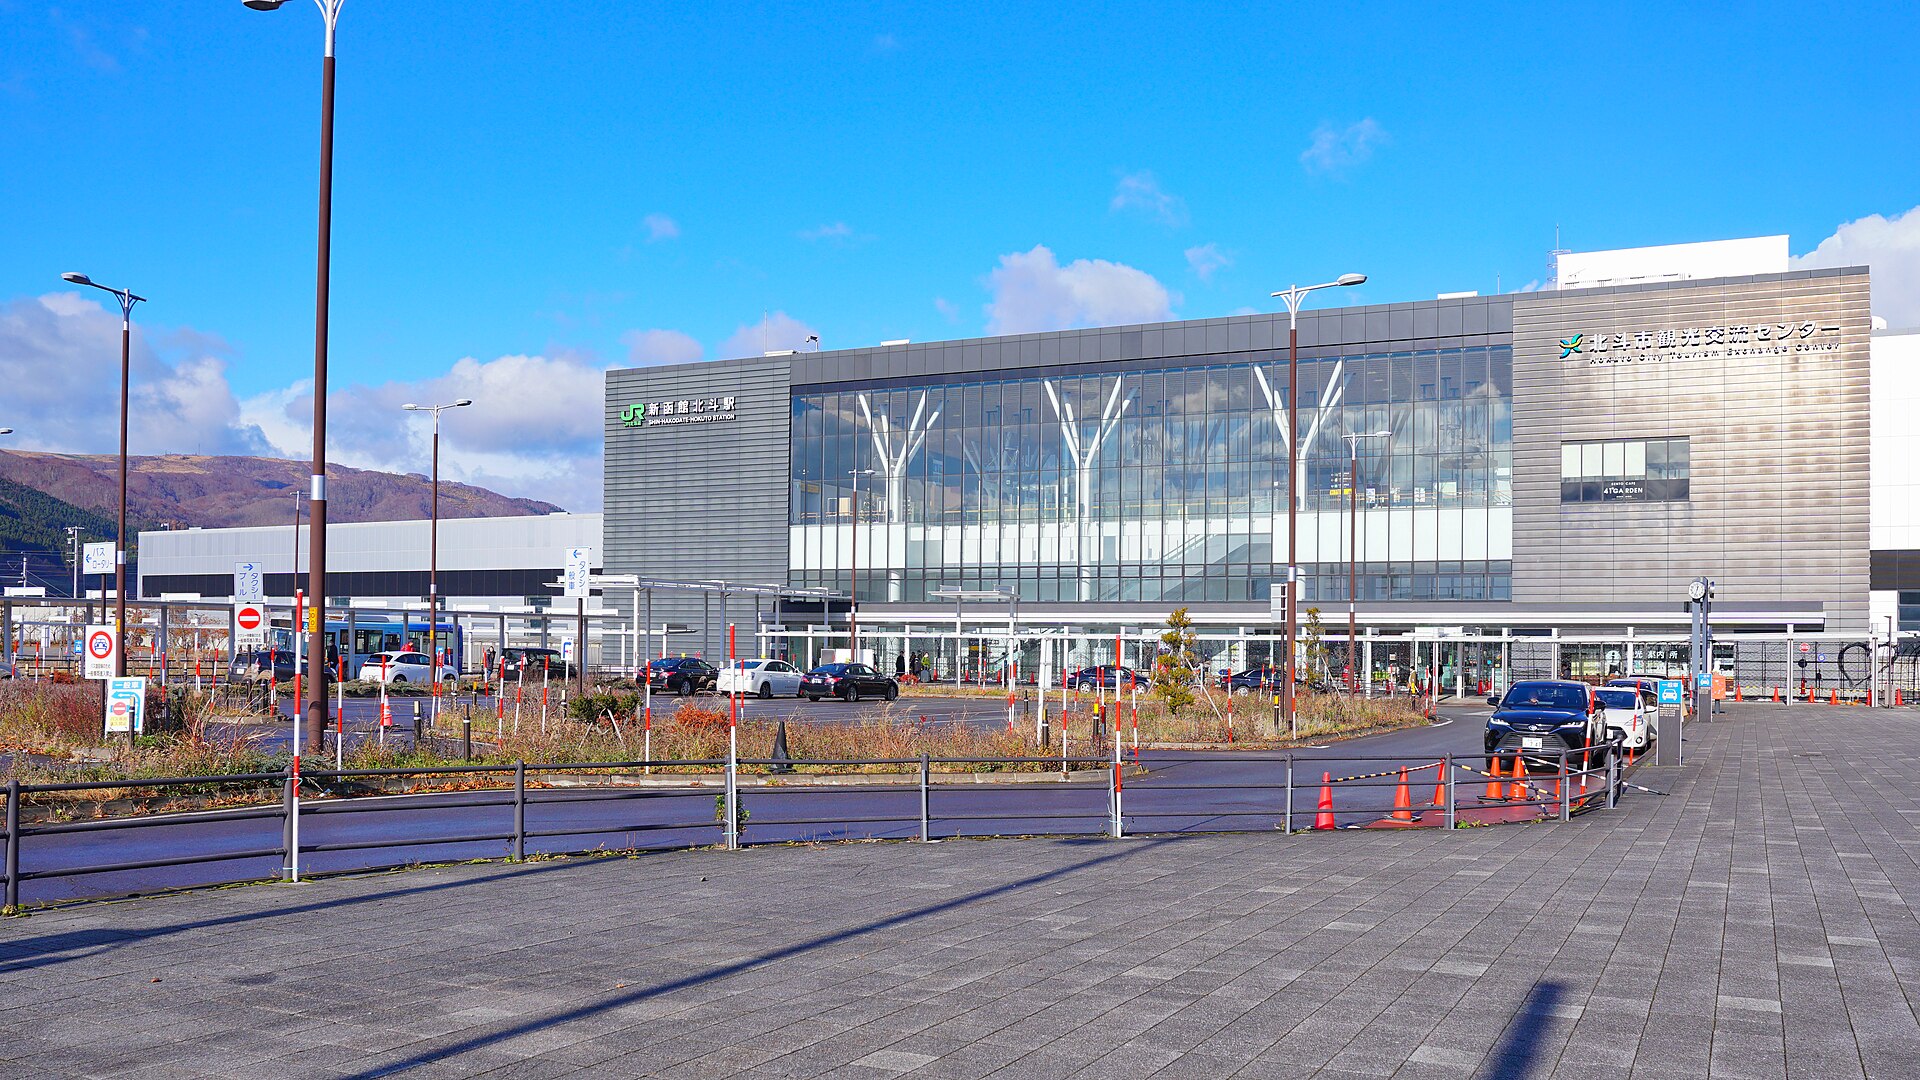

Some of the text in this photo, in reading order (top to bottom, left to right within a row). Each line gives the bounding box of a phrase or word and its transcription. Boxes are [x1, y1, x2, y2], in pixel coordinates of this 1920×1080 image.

[1589, 320, 1841, 353] 北斗市観光交流センター
[1669, 350, 1720, 360] Tourism
[1726, 346, 1788, 357] Exchange
[1795, 342, 1840, 352] Center
[620, 403, 645, 421] JR
[649, 396, 736, 416] 新函館北斗駅
[713, 413, 735, 421] STATION
[93, 547, 105, 557] バス
[92, 559, 113, 569] ロータリー
[239, 572, 248, 596] プール
[250, 572, 259, 600] タクシー
[578, 560, 586, 595] タクシー
[115, 681, 140, 689] 一般車
